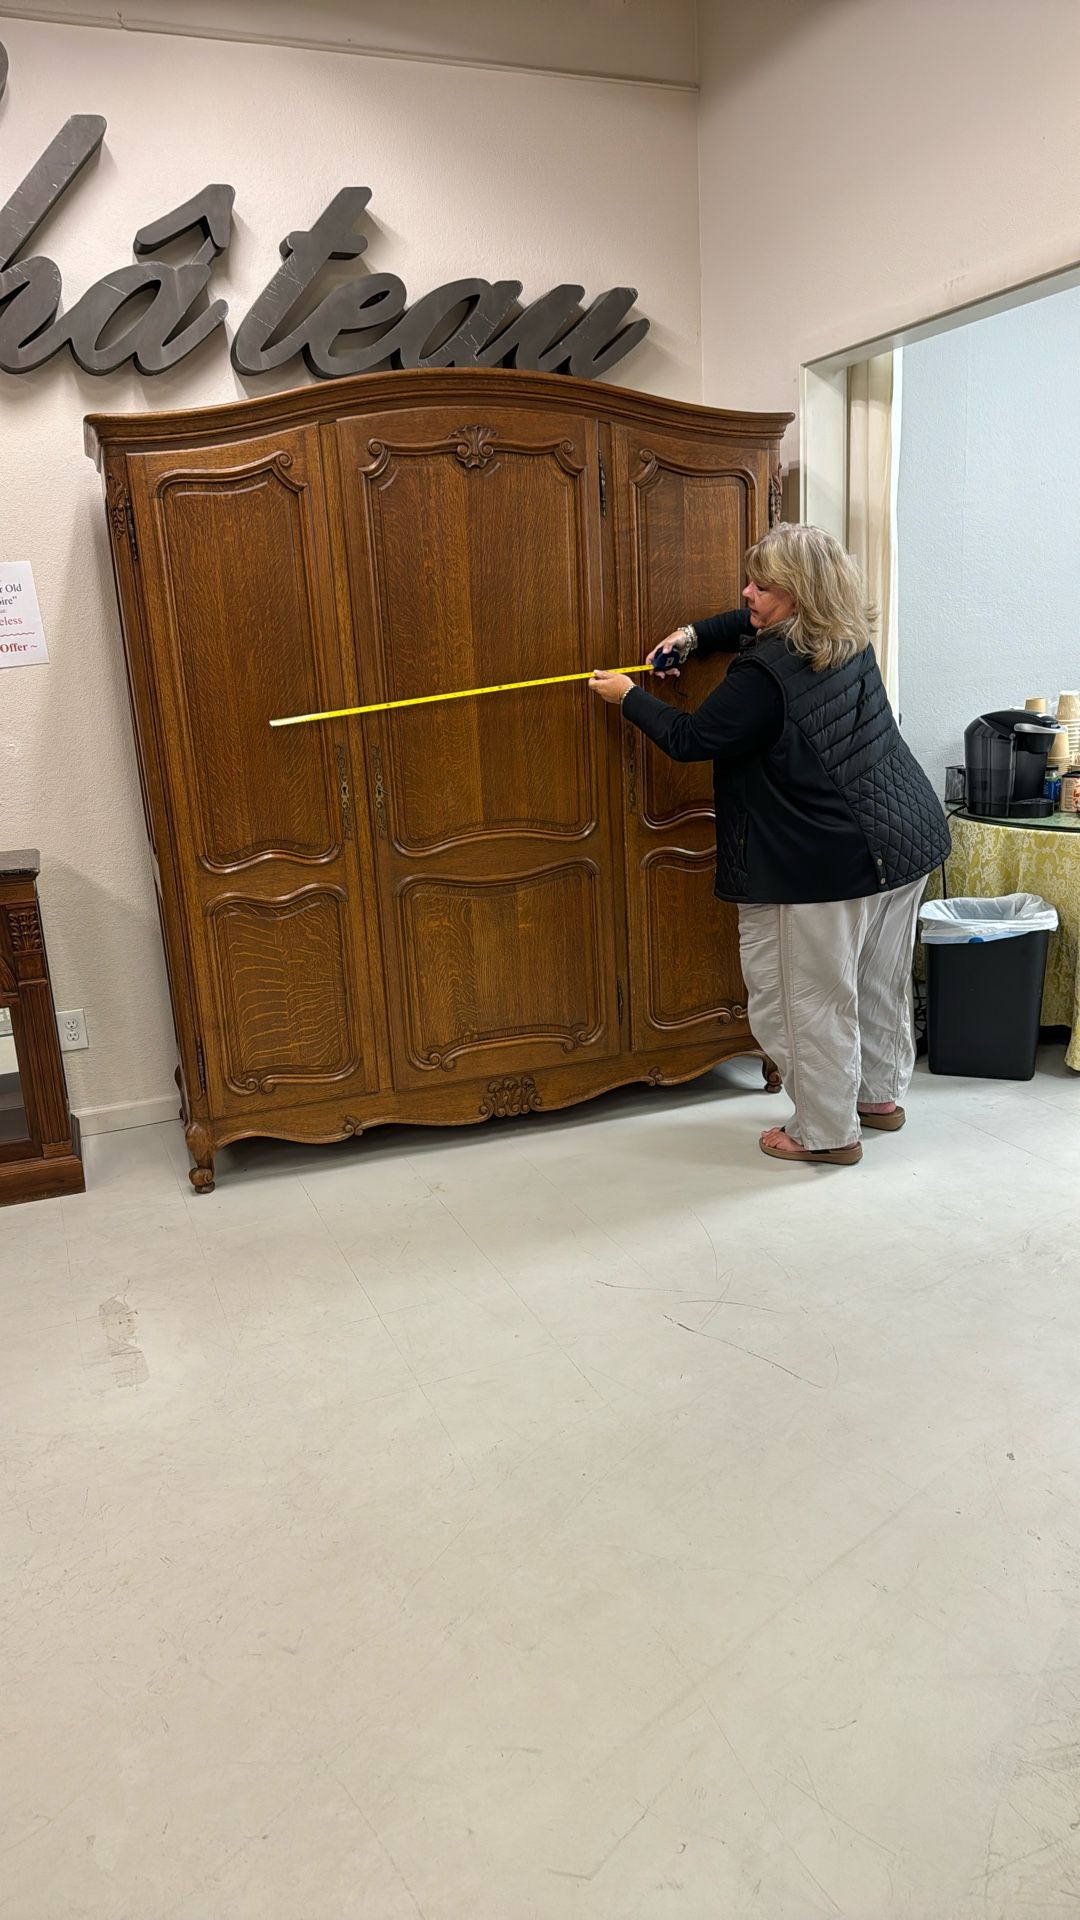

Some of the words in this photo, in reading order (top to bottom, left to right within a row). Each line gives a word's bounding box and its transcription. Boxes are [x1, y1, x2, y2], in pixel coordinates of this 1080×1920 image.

[0, 41, 650, 377] hâteau
[5, 583, 22, 593] Old
[0, 596, 17, 605] ire"
[0, 616, 23, 626] eless
[0, 643, 28, 653] Offer
